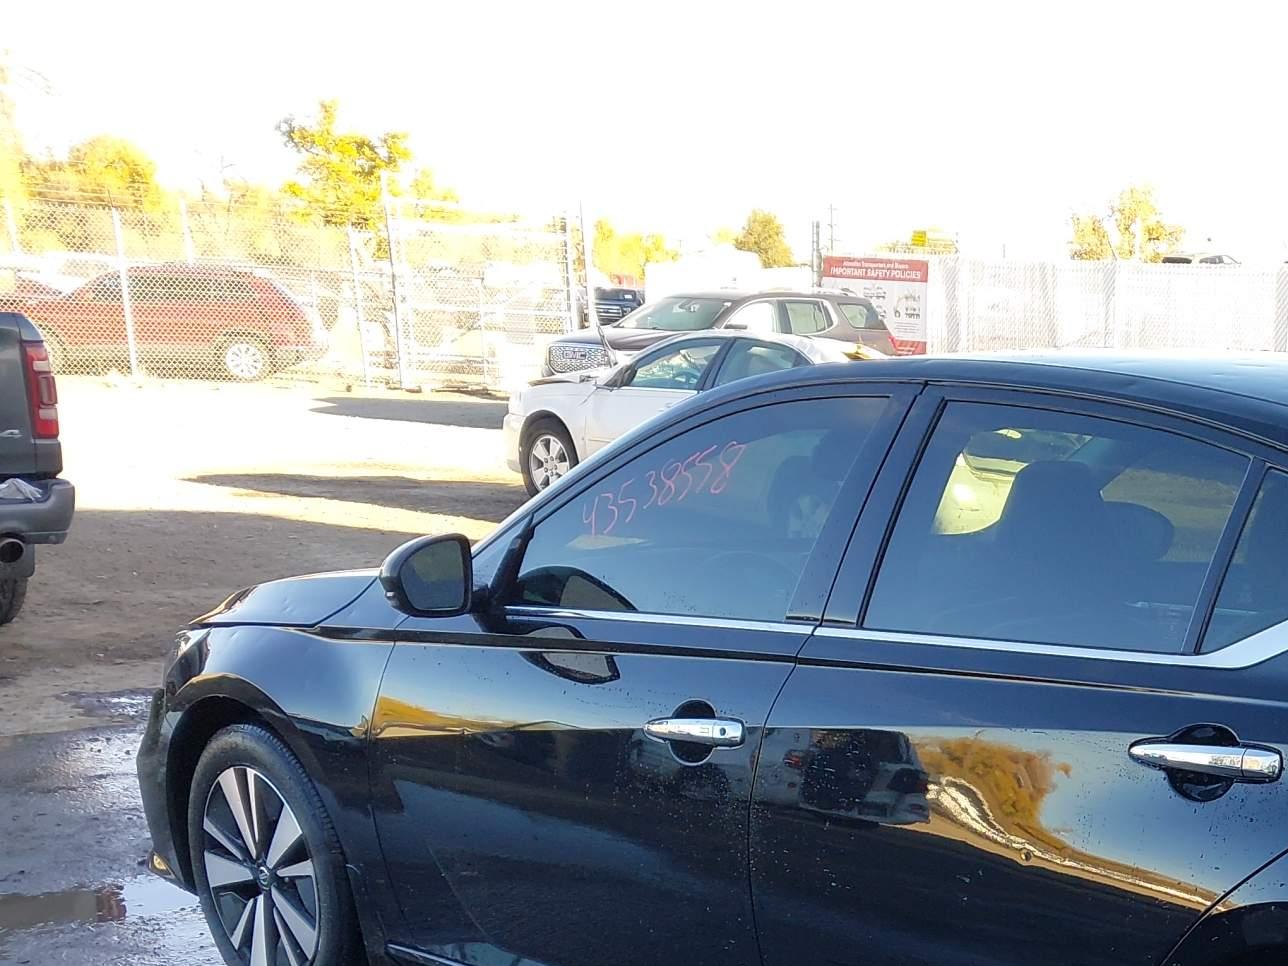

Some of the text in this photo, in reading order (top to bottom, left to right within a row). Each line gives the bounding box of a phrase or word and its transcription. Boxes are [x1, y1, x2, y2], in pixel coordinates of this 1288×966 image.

[830, 267, 921, 279] IMPORTANT SAFETY POLICIES
[563, 350, 586, 360] GMC
